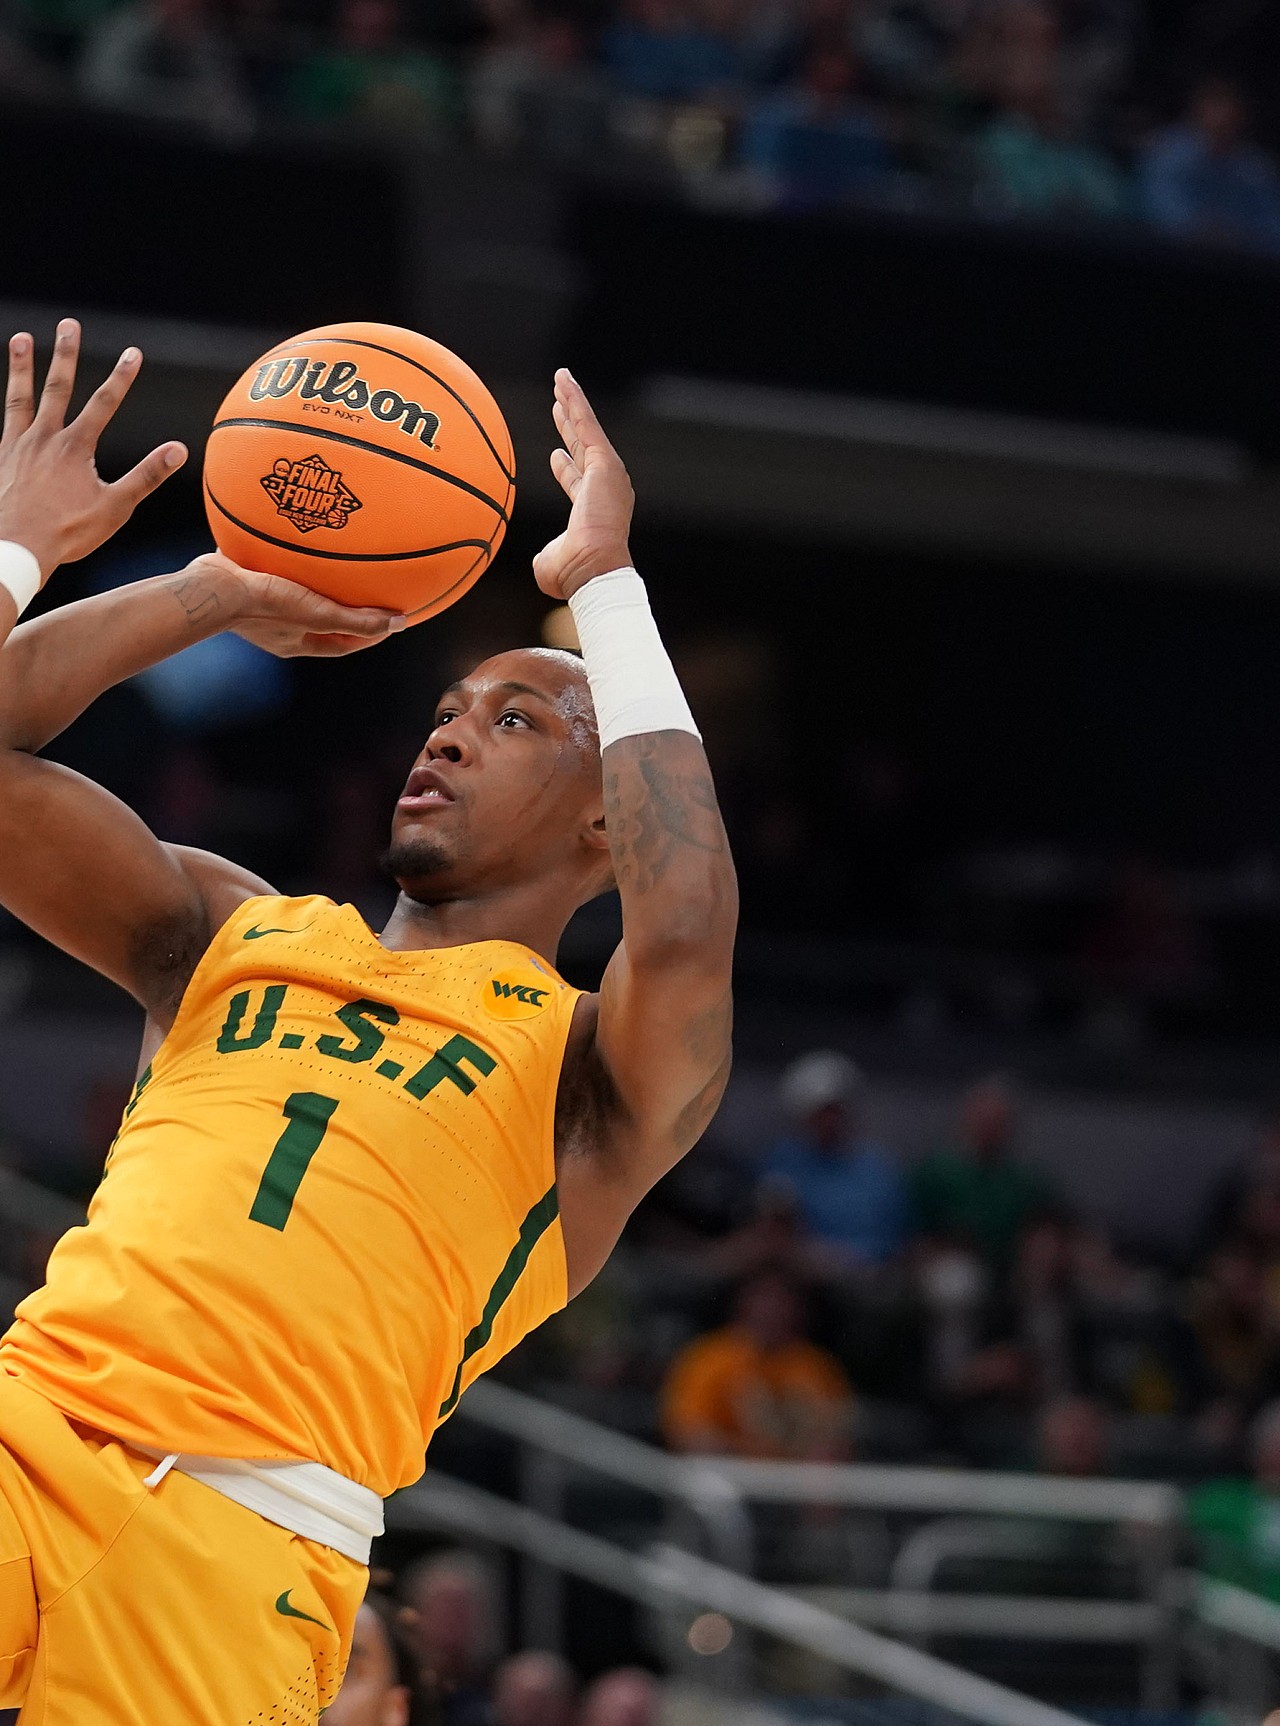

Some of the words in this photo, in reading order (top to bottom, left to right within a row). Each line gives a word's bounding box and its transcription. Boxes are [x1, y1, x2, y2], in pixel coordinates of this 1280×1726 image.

[248, 356, 442, 449] Wilson
[302, 403, 331, 415] EVO
[334, 409, 365, 424] NXT
[287, 464, 341, 493] FINAL
[281, 484, 336, 513] FOUR
[491, 979, 551, 1008] WCC
[216, 985, 498, 1101] U.S.F
[248, 1092, 340, 1232] 1
